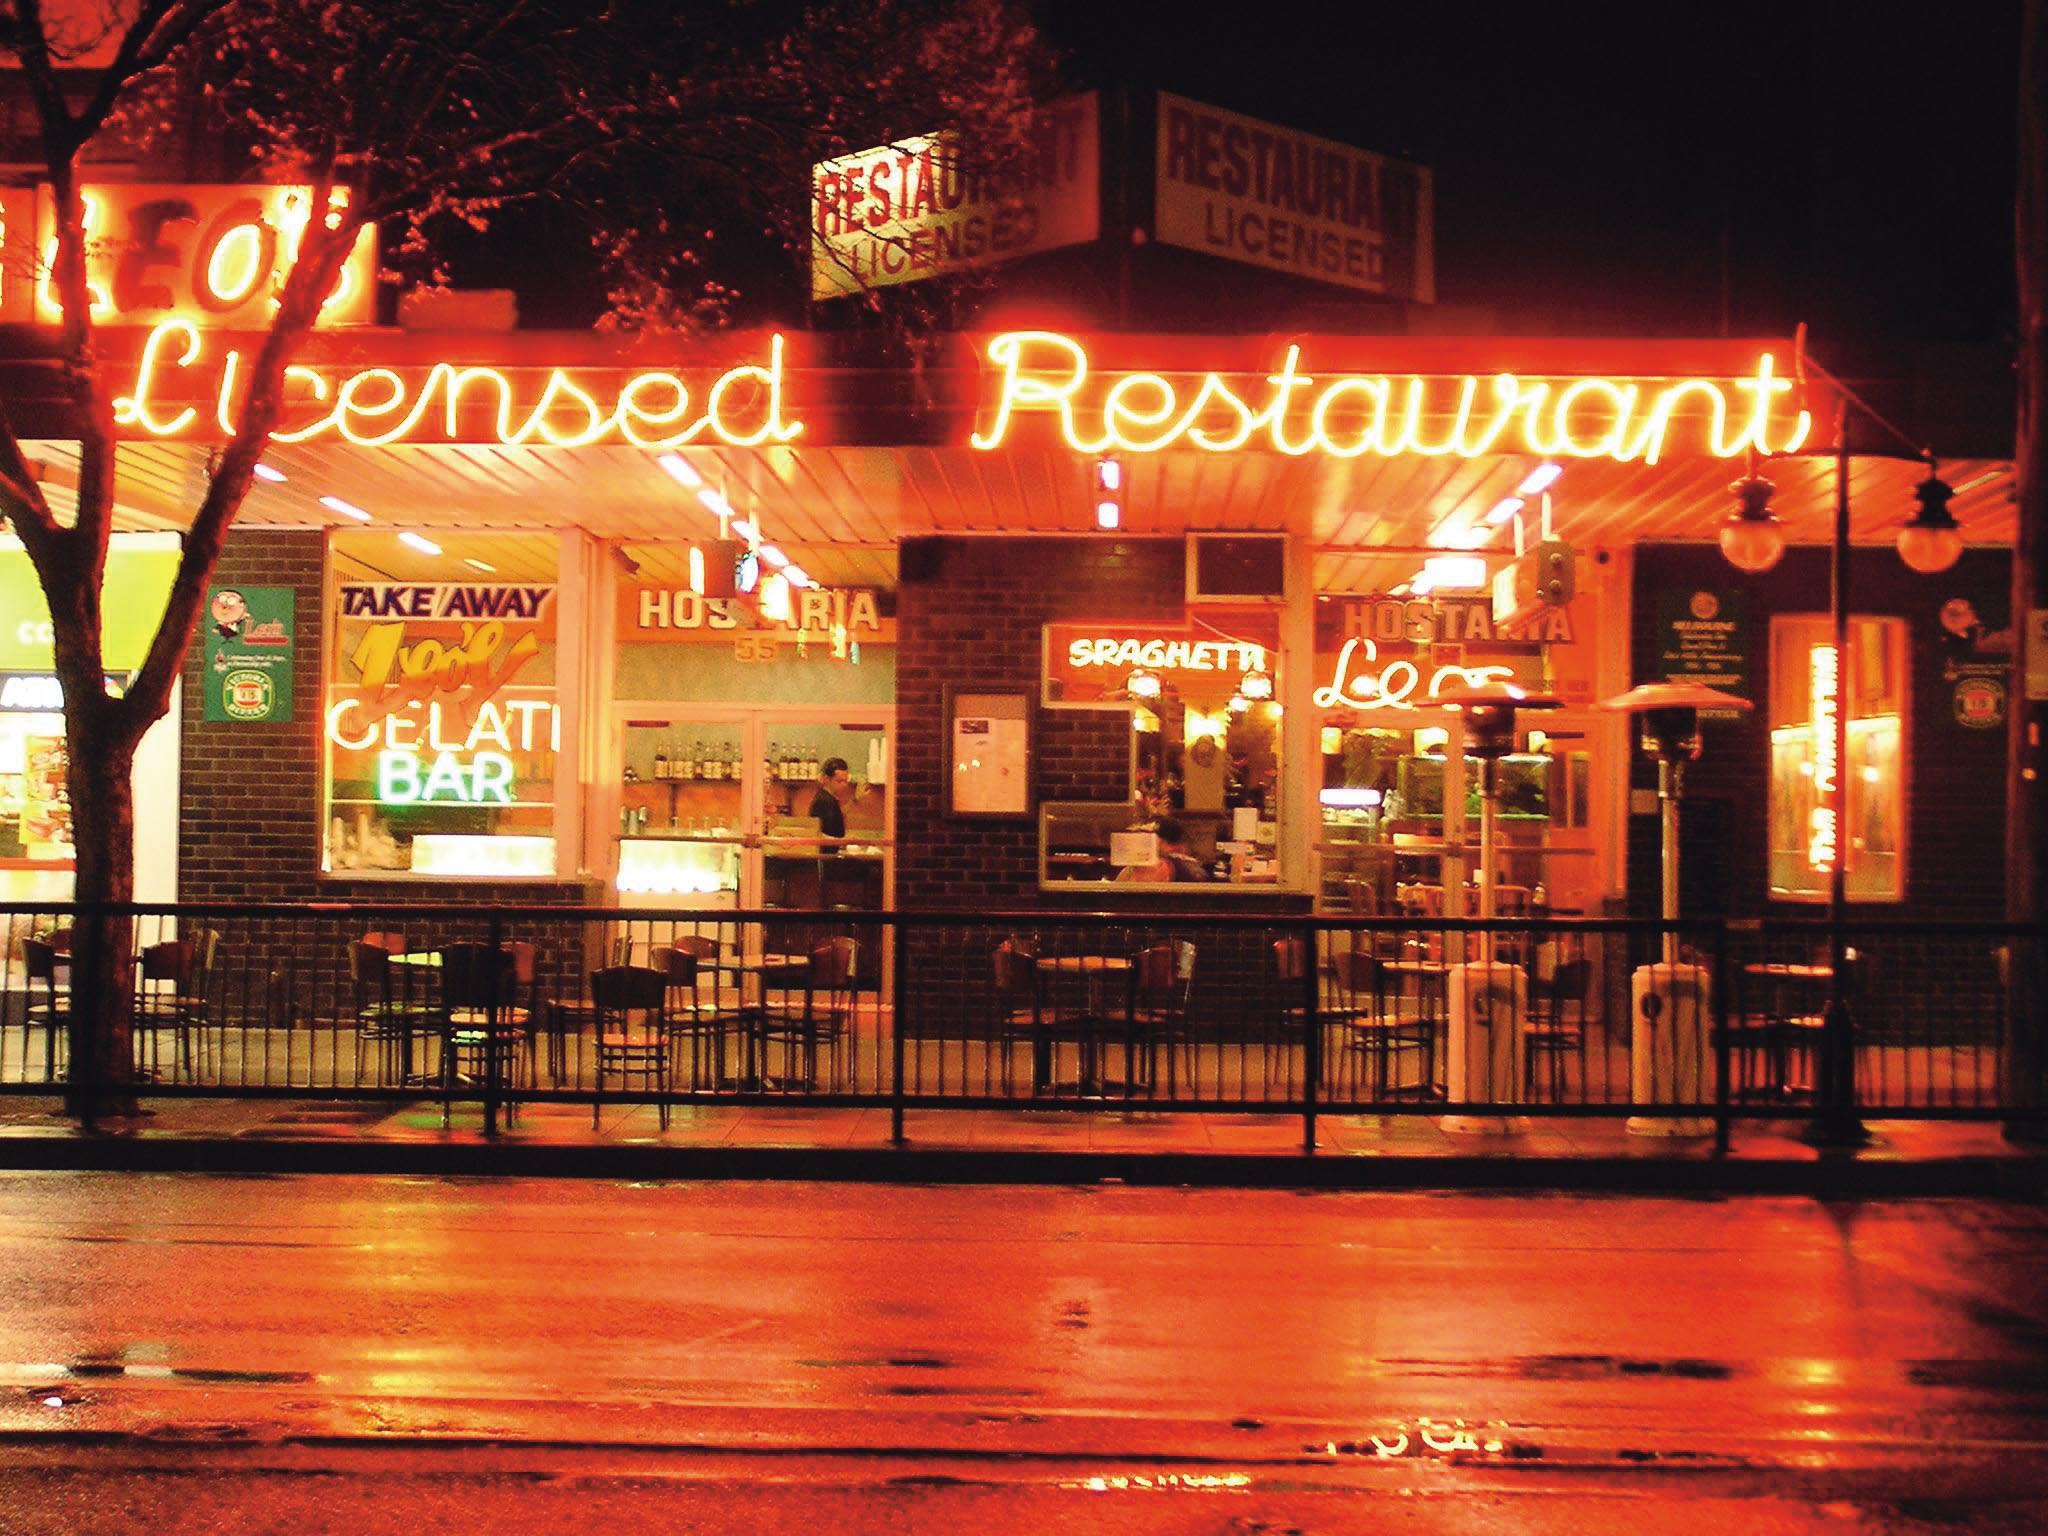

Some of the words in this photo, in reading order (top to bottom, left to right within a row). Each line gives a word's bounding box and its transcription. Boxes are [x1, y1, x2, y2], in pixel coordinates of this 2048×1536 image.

[113, 320, 804, 447] Licensed
[971, 330, 1812, 465] Restaurant
[379, 749, 513, 804] BAR
